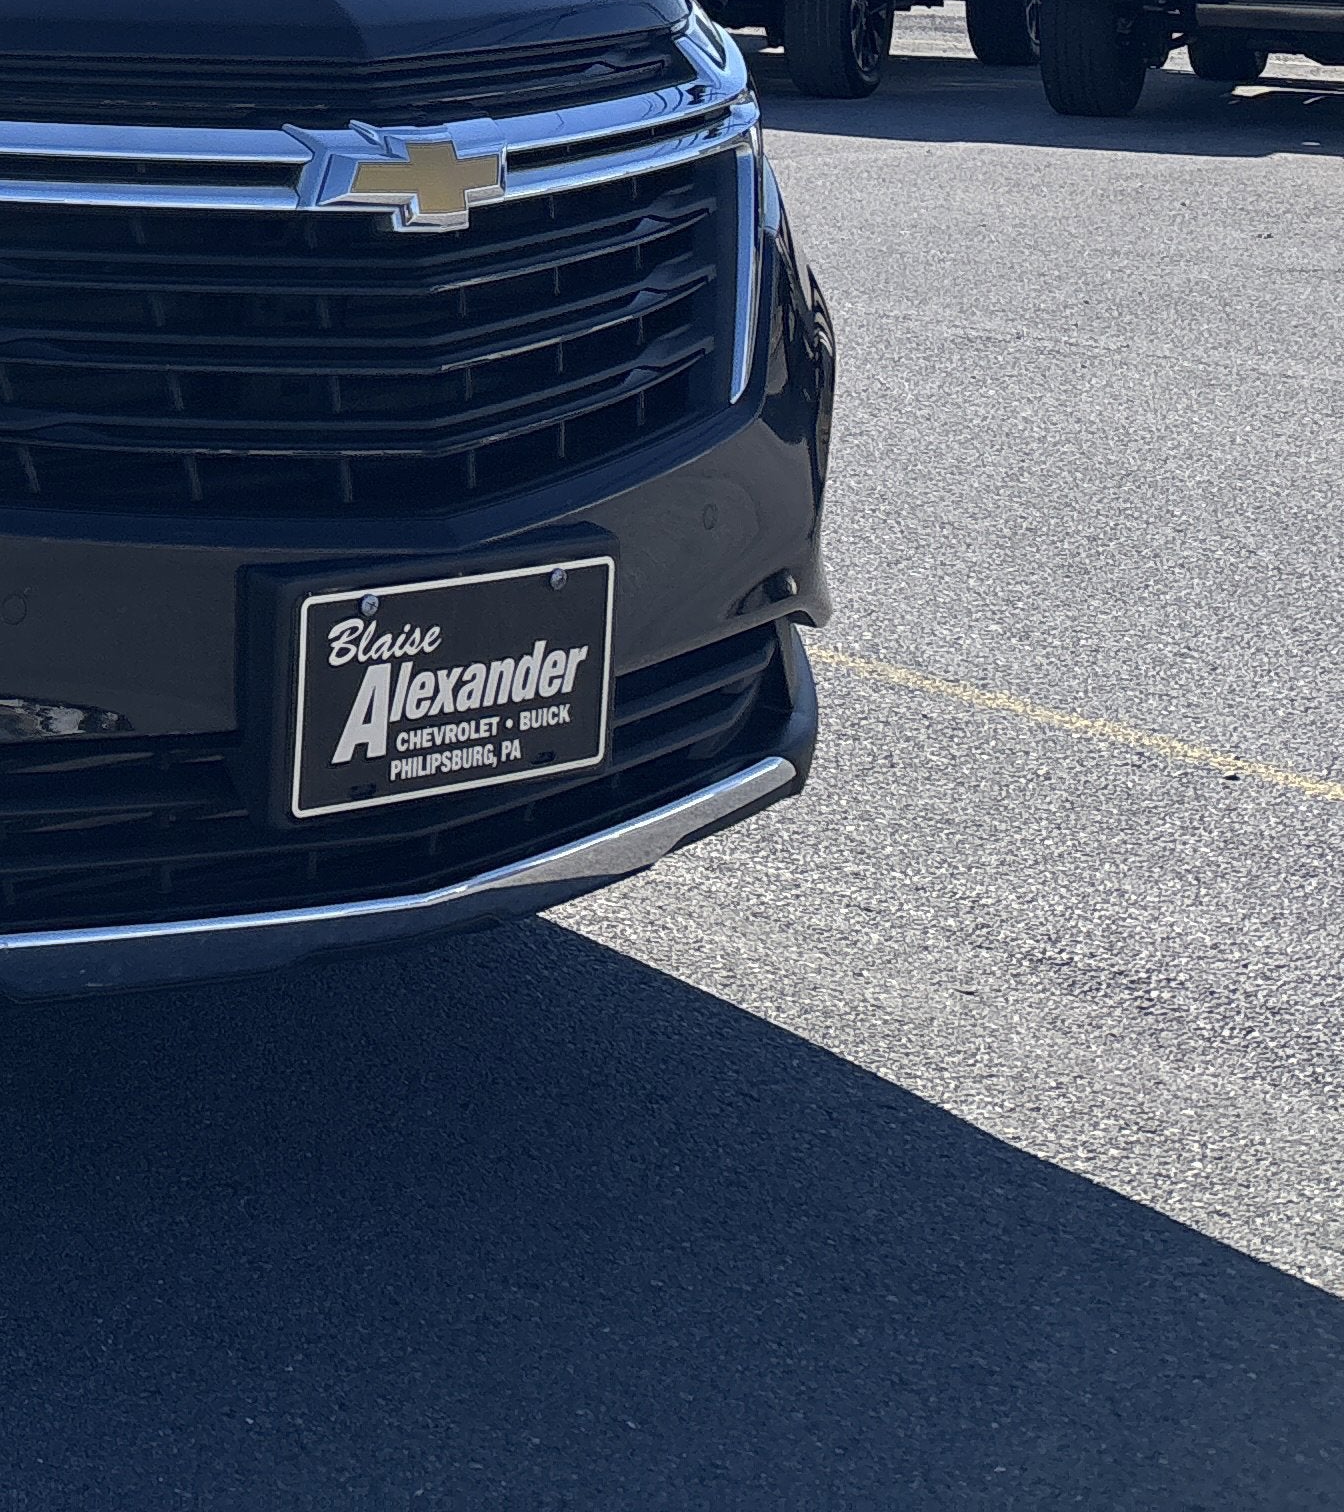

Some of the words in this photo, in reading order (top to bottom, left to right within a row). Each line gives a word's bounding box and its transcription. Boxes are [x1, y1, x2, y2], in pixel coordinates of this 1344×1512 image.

[328, 618, 442, 666] Blaise
[331, 640, 589, 765] Alexander
[396, 716, 501, 752] CHEVROLET
[519, 703, 571, 731] BUICK
[390, 745, 498, 782] PHILIPSBURG,
[501, 739, 522, 761] PA
